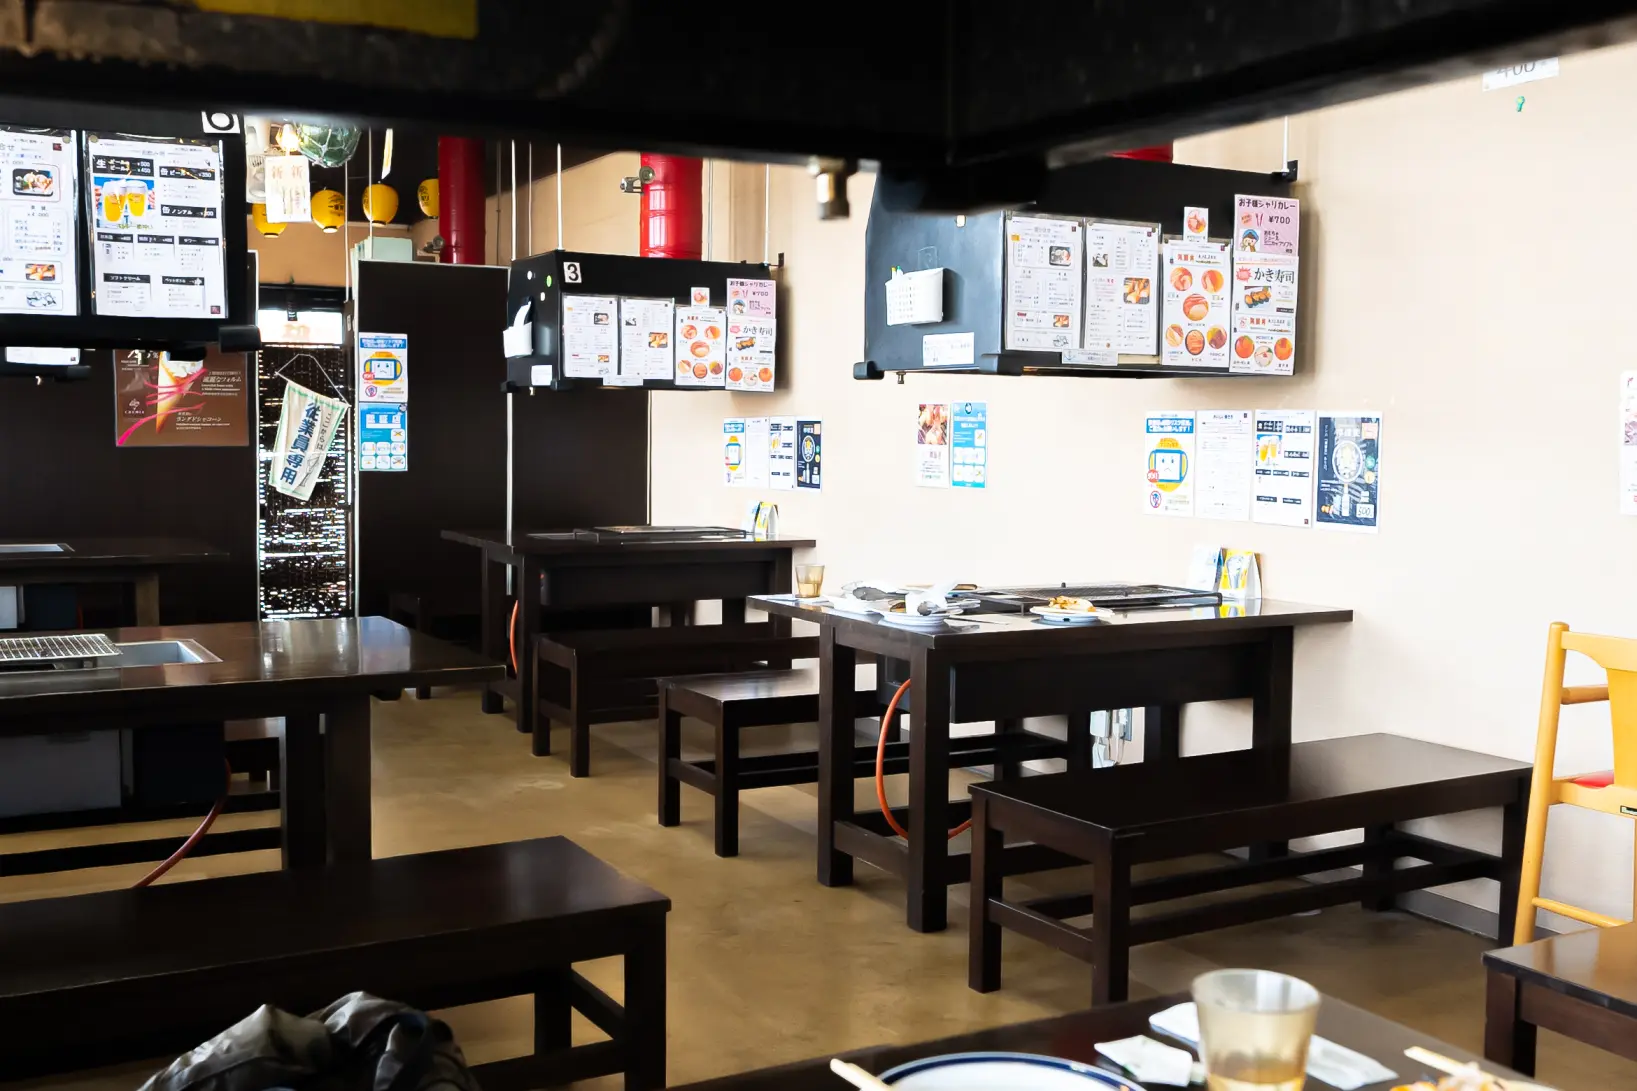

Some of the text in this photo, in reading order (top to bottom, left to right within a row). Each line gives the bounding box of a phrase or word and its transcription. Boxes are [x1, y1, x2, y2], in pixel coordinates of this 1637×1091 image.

[1239, 198, 1296, 210] お子様シャリカレー
[1268, 215, 1291, 225] ¥700
[567, 263, 579, 281] 3
[1254, 267, 1295, 284] かき寿司
[742, 325, 773, 336] かき寿司
[280, 402, 321, 485] 従業員専用
